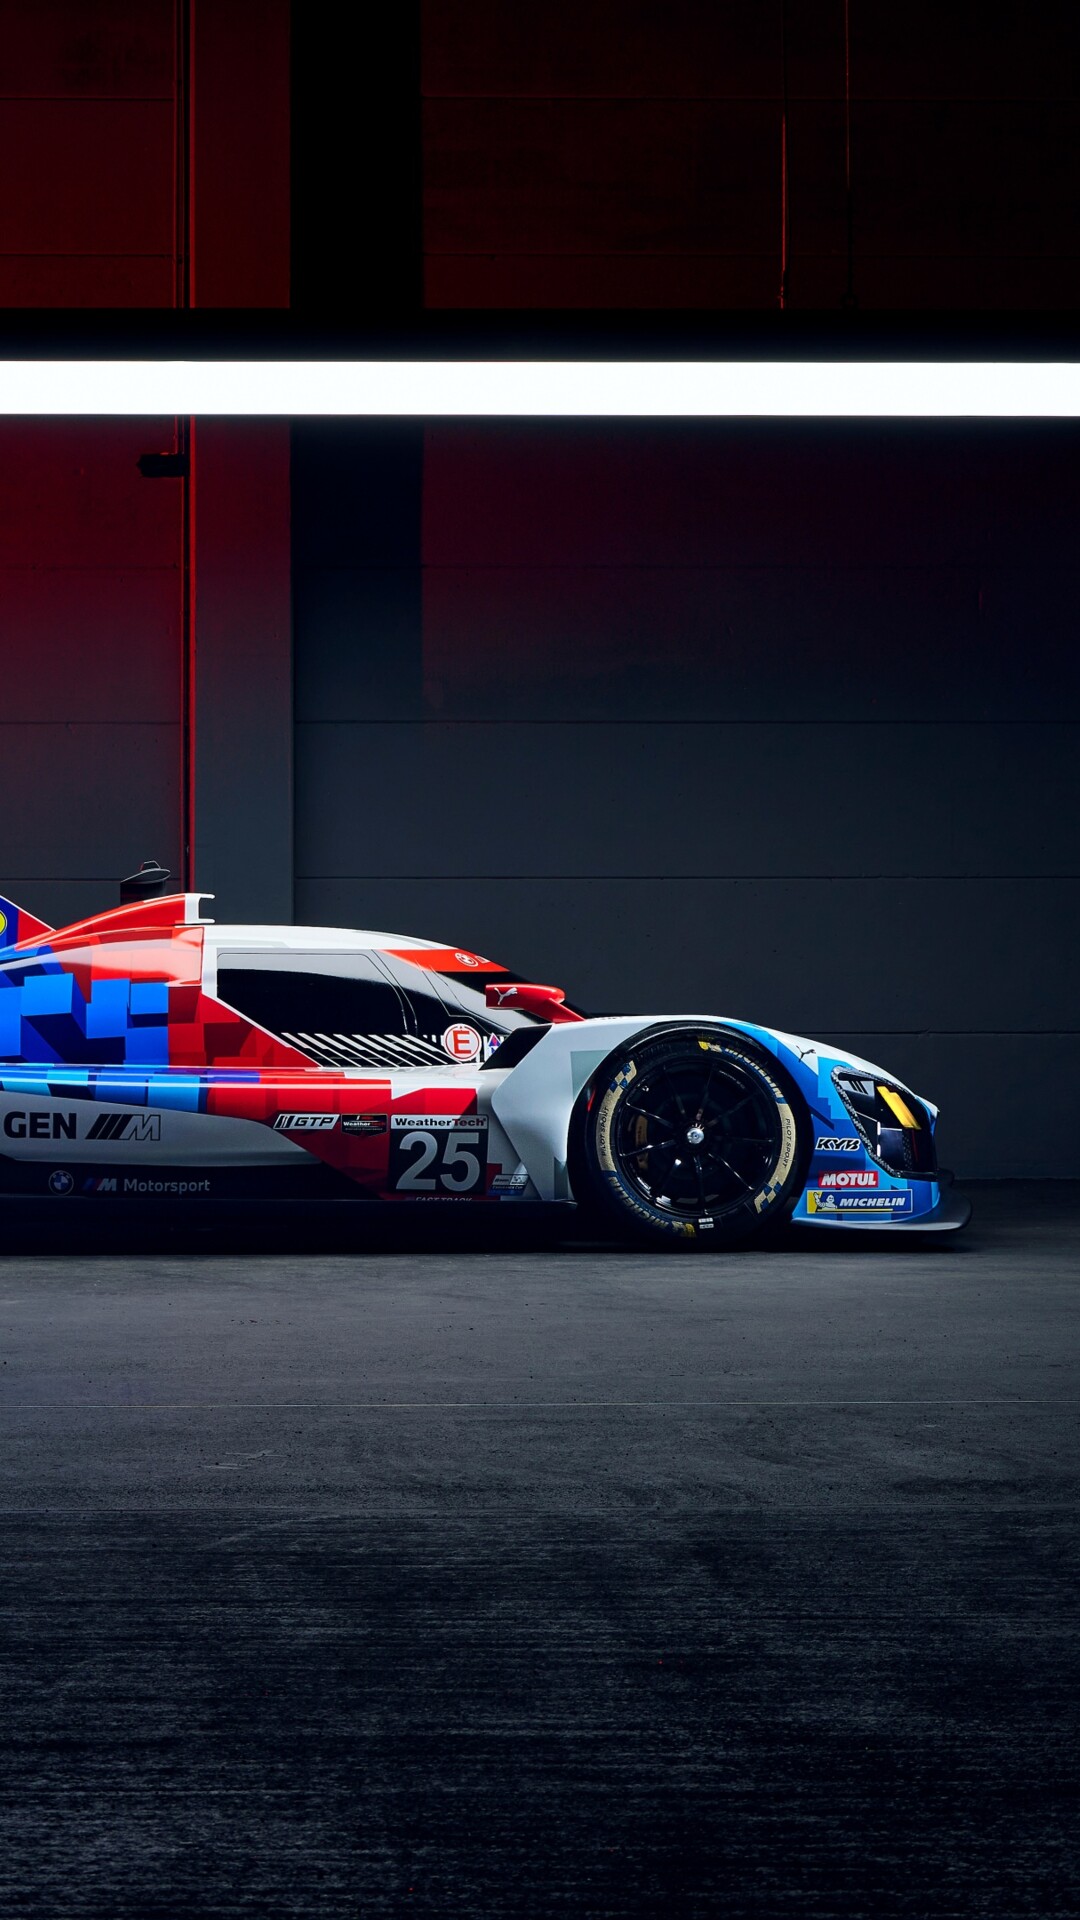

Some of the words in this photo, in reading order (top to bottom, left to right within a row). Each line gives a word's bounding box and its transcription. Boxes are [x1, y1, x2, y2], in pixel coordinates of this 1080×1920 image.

[453, 1030, 472, 1055] E
[724, 1047, 785, 1099] MICHELIN
[294, 1116, 335, 1127] GTP
[394, 1117, 486, 1127] WeatherTech
[785, 1118, 793, 1138] PILOT
[816, 1137, 860, 1151] KYB
[396, 1131, 481, 1191] 25
[783, 1141, 792, 1169] SPORT
[123, 1178, 211, 1194] Motorsport
[821, 1173, 876, 1186] MOTUL
[839, 1197, 905, 1207] MICHELIN
